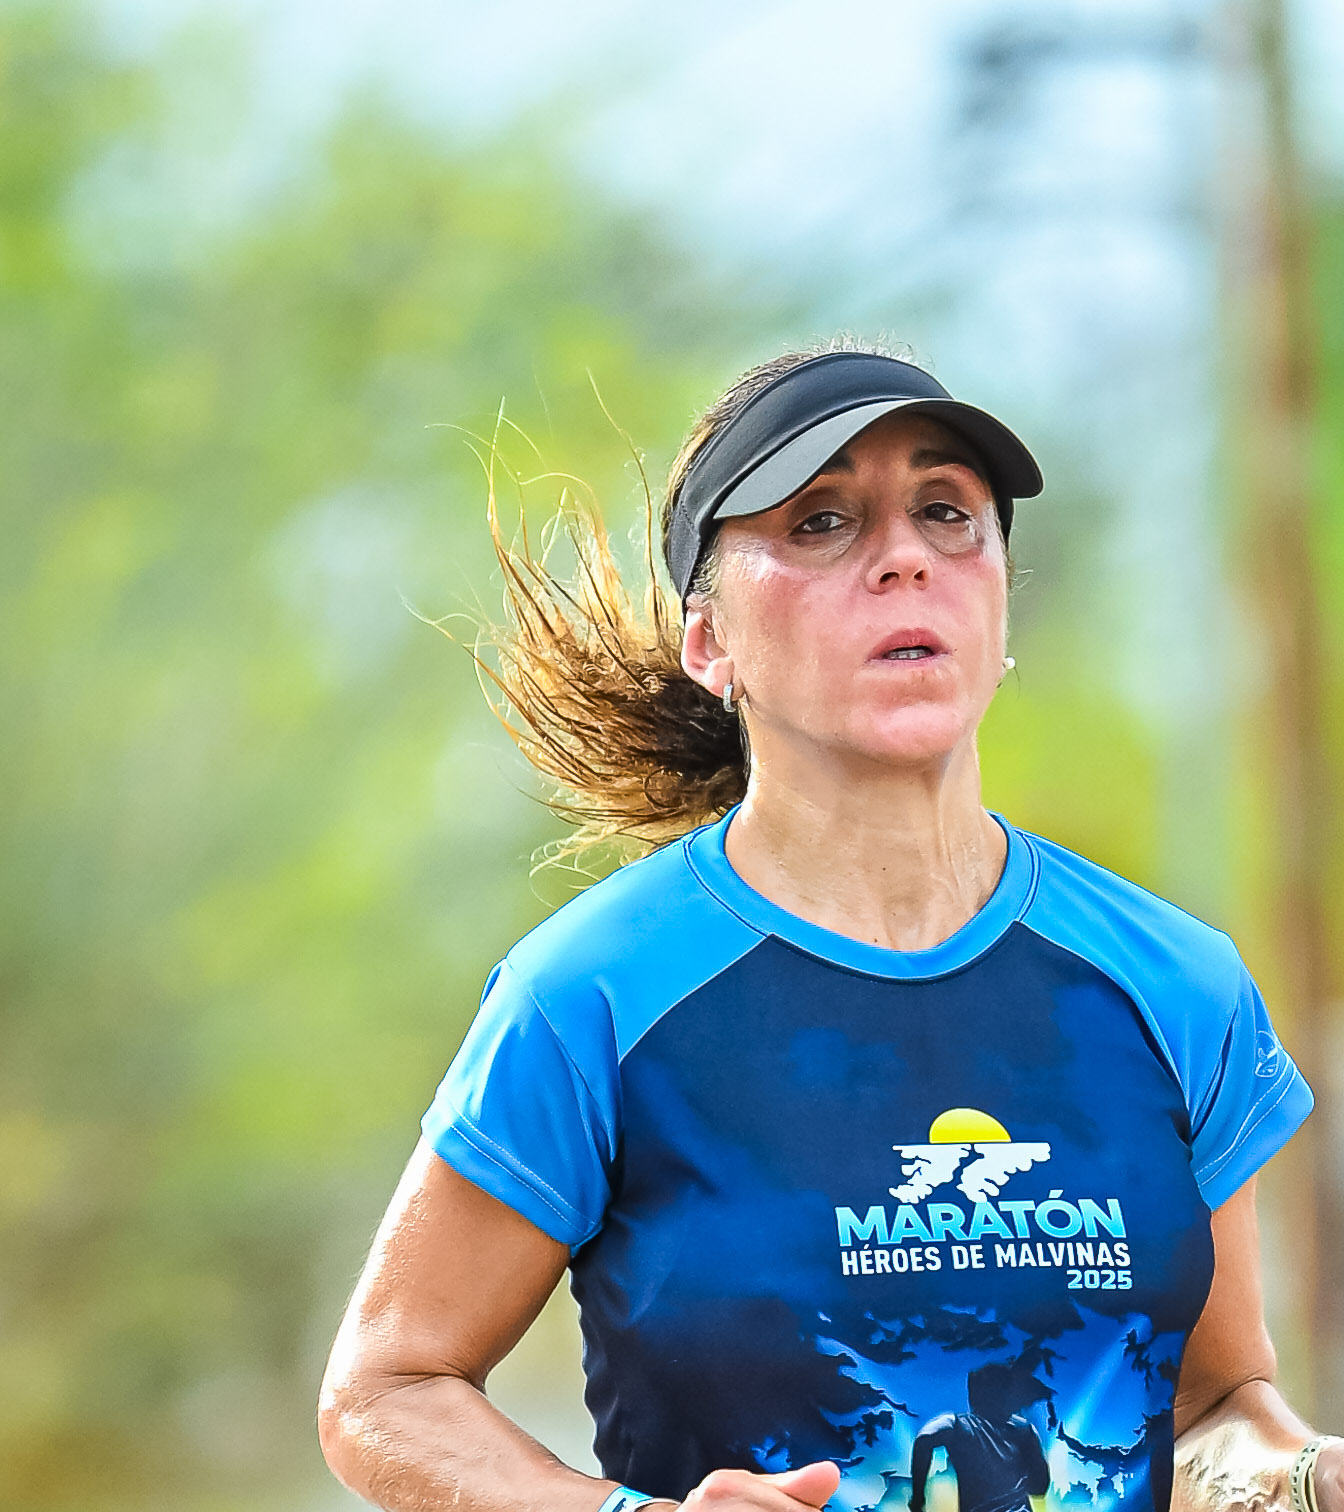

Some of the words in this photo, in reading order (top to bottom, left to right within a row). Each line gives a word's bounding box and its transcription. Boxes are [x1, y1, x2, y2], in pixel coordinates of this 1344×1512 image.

[834, 1189, 1127, 1246] MARATÓN
[841, 1244, 942, 1275] HÉROES
[950, 1245, 986, 1270] DE
[994, 1242, 1131, 1268] MALVINAS
[1066, 1269, 1133, 1290] 2025
